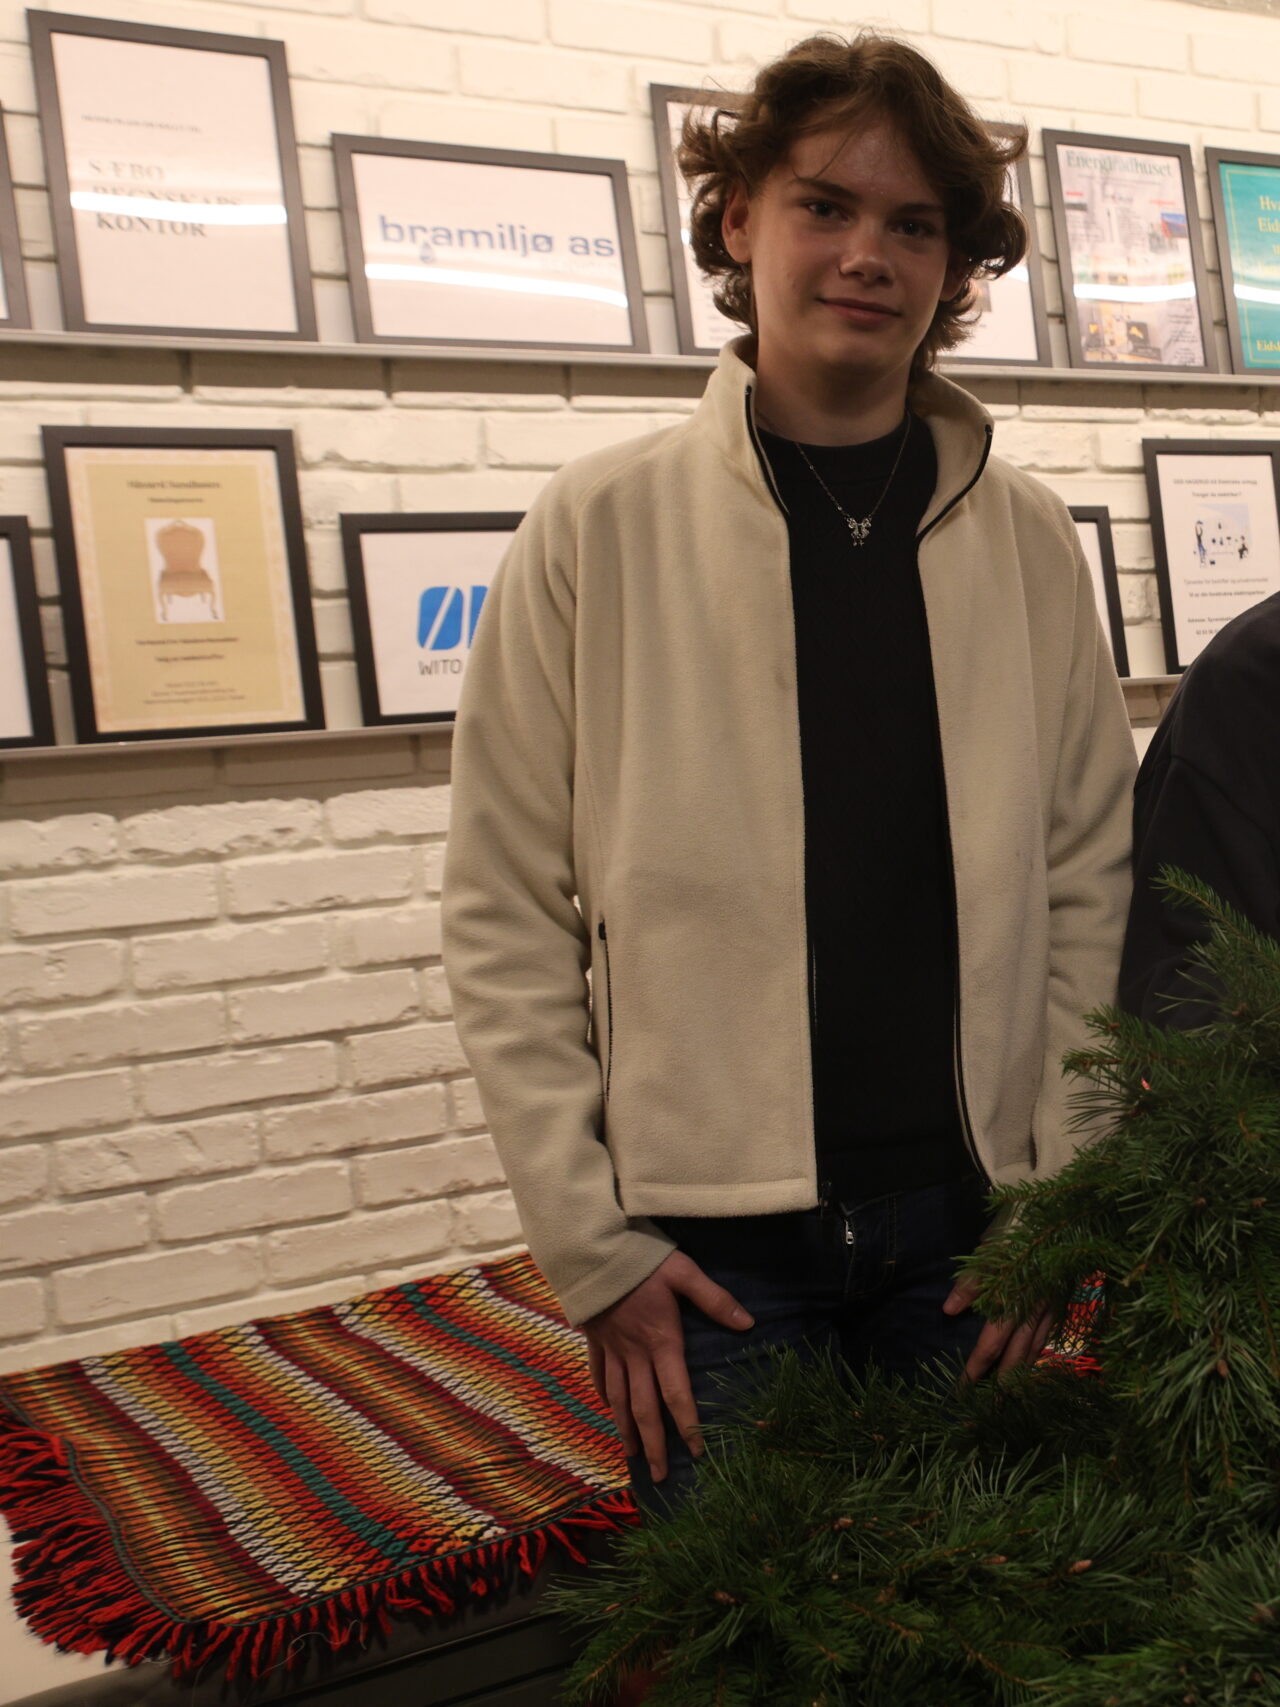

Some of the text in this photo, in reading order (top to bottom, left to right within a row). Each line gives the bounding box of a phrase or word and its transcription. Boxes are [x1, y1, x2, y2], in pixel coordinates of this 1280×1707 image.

[95, 212, 208, 238] KONTOR
[378, 214, 616, 258] bramiljø as
[417, 658, 463, 676] WITO
